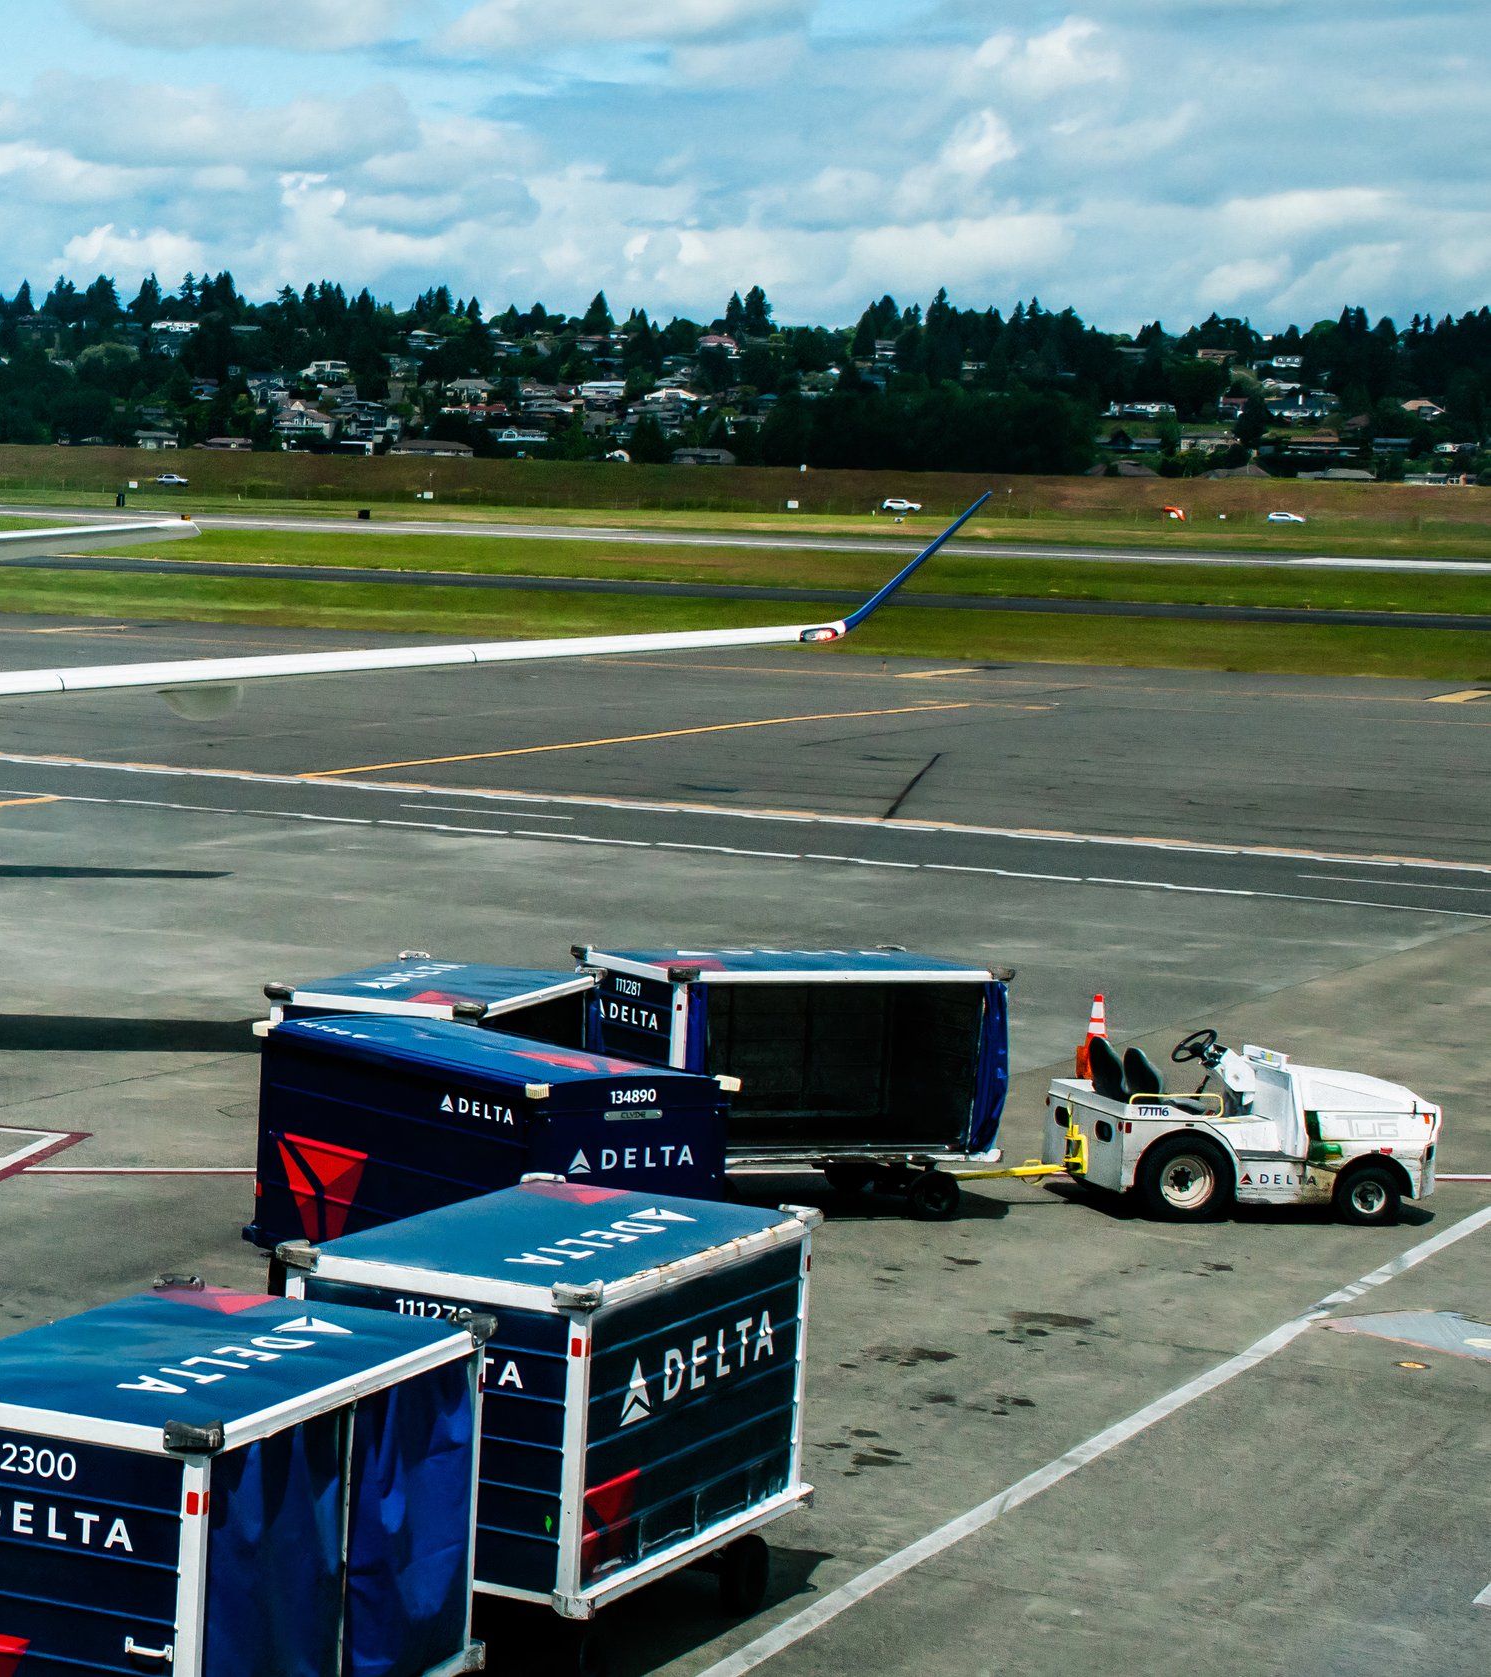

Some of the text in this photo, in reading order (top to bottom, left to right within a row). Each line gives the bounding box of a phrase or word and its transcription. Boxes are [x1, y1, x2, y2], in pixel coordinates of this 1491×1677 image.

[615, 977, 641, 997] 111281
[610, 1002, 658, 1031] DELTA
[610, 1088, 657, 1104] 134890
[458, 1097, 513, 1126] DELTA
[1335, 1114, 1399, 1138] TUG
[601, 1145, 694, 1170] DELTA
[1259, 1173, 1317, 1186] DELTA
[503, 1220, 668, 1266] DELTA
[395, 1298, 472, 1322] 11127
[116, 1336, 316, 1394] DELTA
[663, 1310, 774, 1401] DELTA
